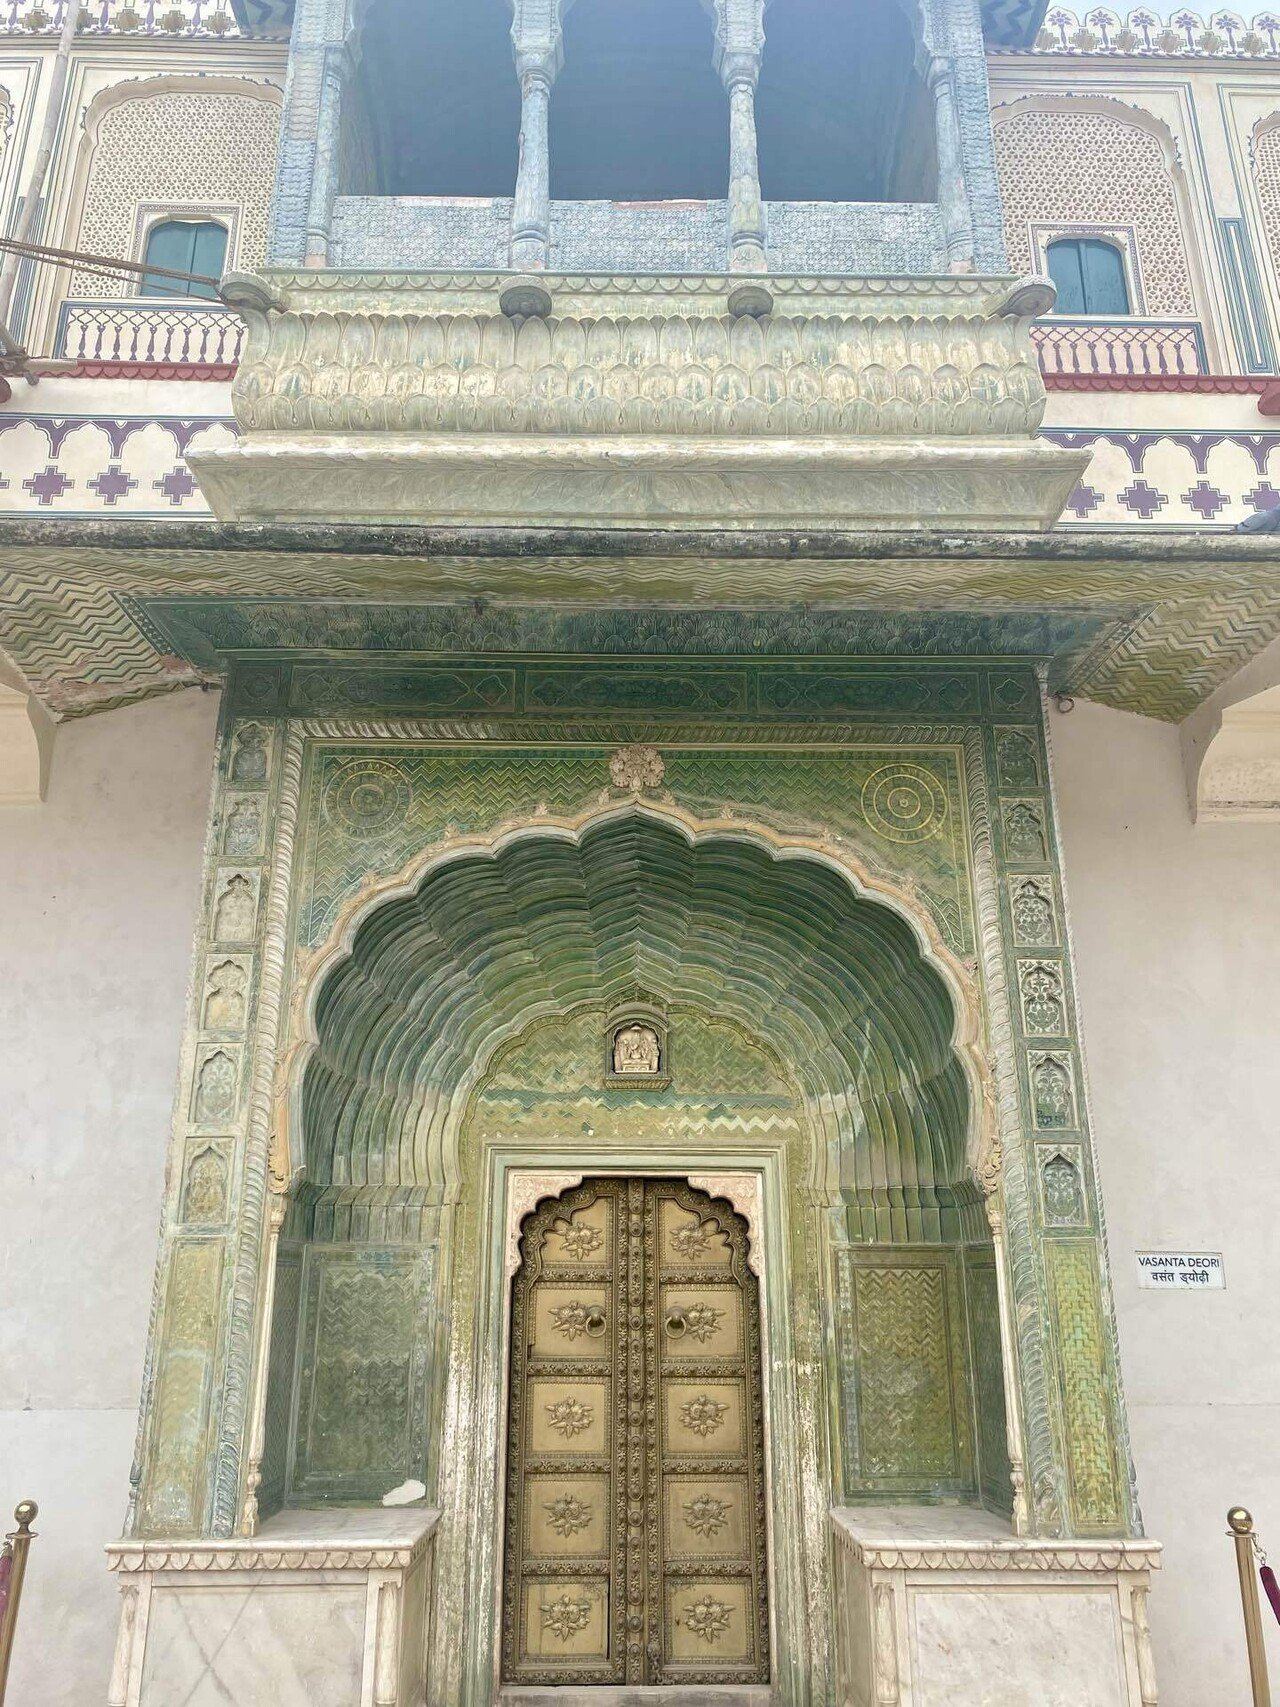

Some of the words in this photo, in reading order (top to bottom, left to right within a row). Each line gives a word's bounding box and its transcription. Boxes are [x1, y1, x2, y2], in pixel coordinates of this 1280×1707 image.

[1138, 1257, 1186, 1267] VASANTA
[1188, 1258, 1220, 1268] DEORI
[1151, 1269, 1175, 1282] वसंत
